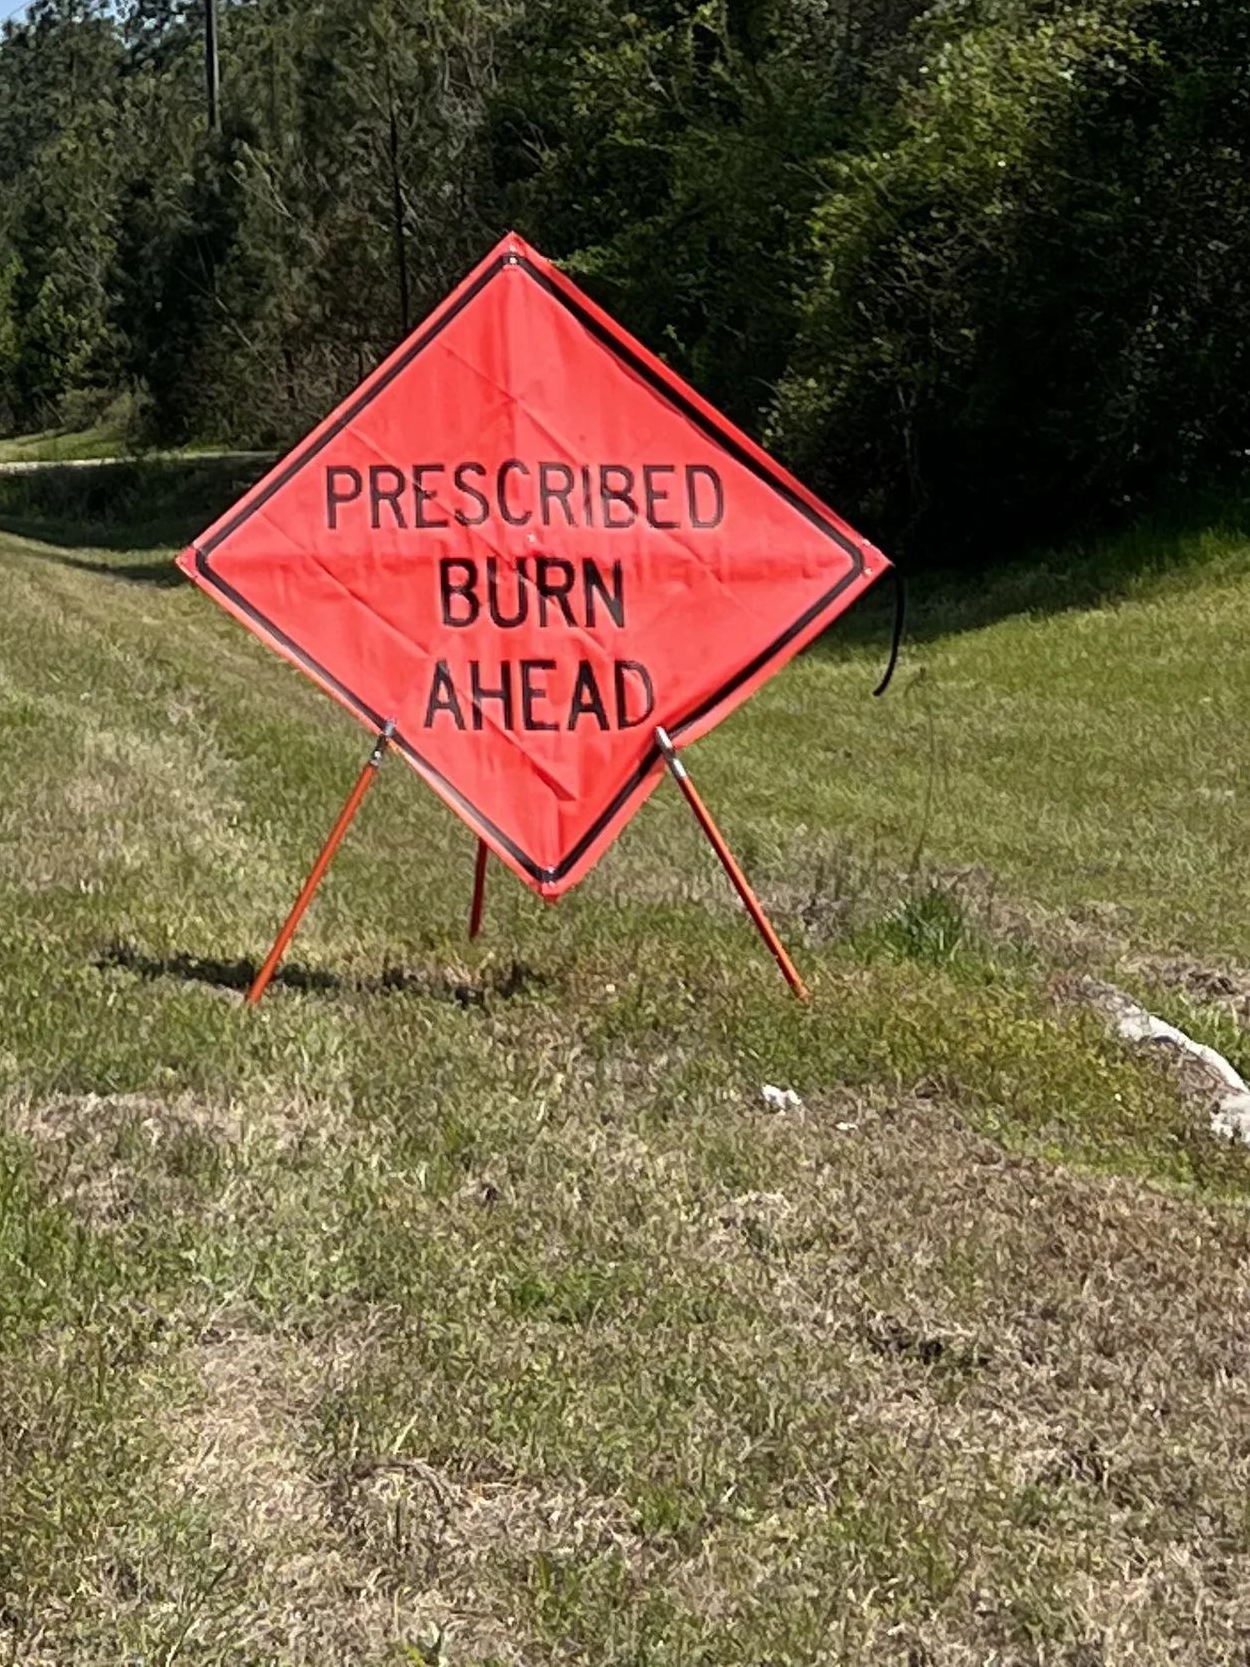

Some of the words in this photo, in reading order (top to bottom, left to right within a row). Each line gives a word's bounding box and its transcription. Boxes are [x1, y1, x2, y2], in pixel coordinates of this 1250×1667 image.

[325, 459, 725, 529] PRESCRIBED
[438, 557, 626, 629] BURN
[423, 659, 656, 732] AHEAD
